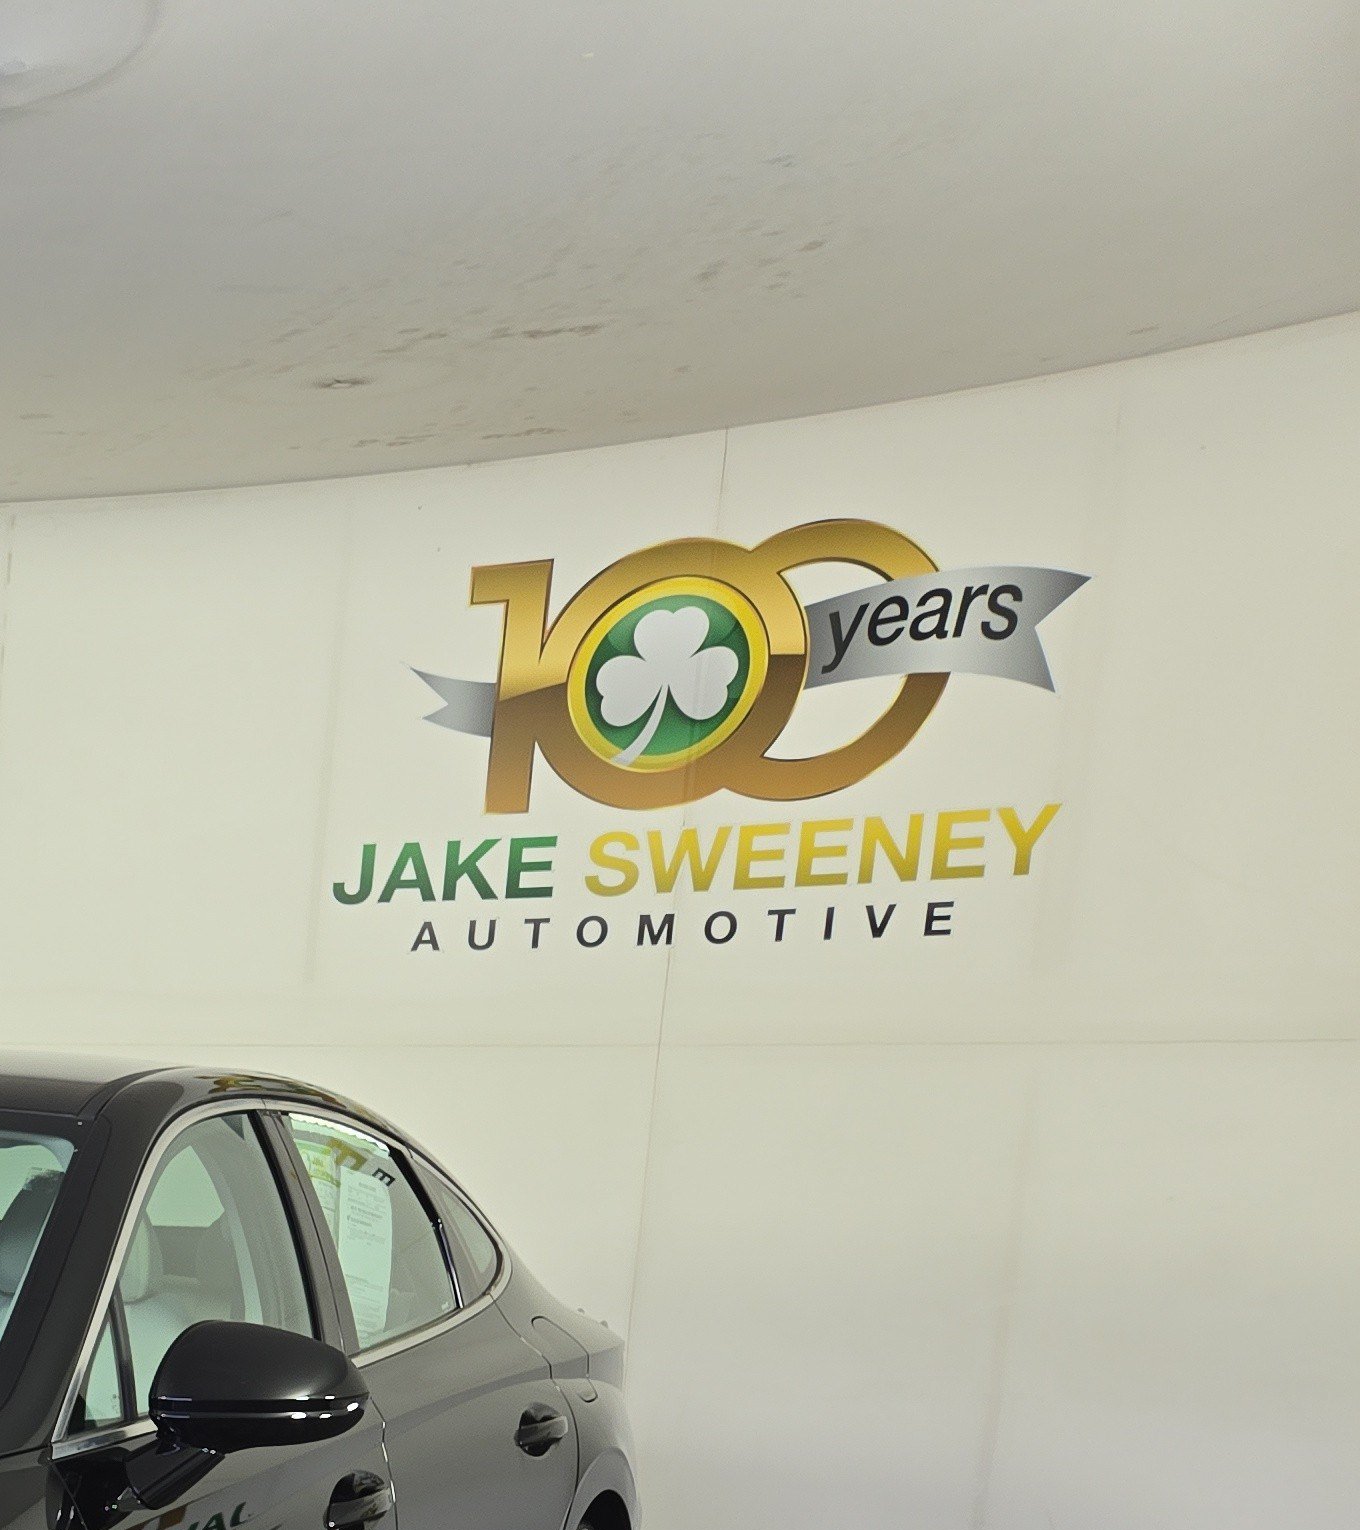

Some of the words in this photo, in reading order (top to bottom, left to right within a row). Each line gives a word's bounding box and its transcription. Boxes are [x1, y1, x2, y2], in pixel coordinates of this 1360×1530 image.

[469, 518, 952, 815] 100
[821, 582, 1024, 675] years
[332, 835, 559, 906] JAKE
[584, 803, 1063, 898] SWEENEY
[410, 900, 956, 953] AUTOMOTIVE
